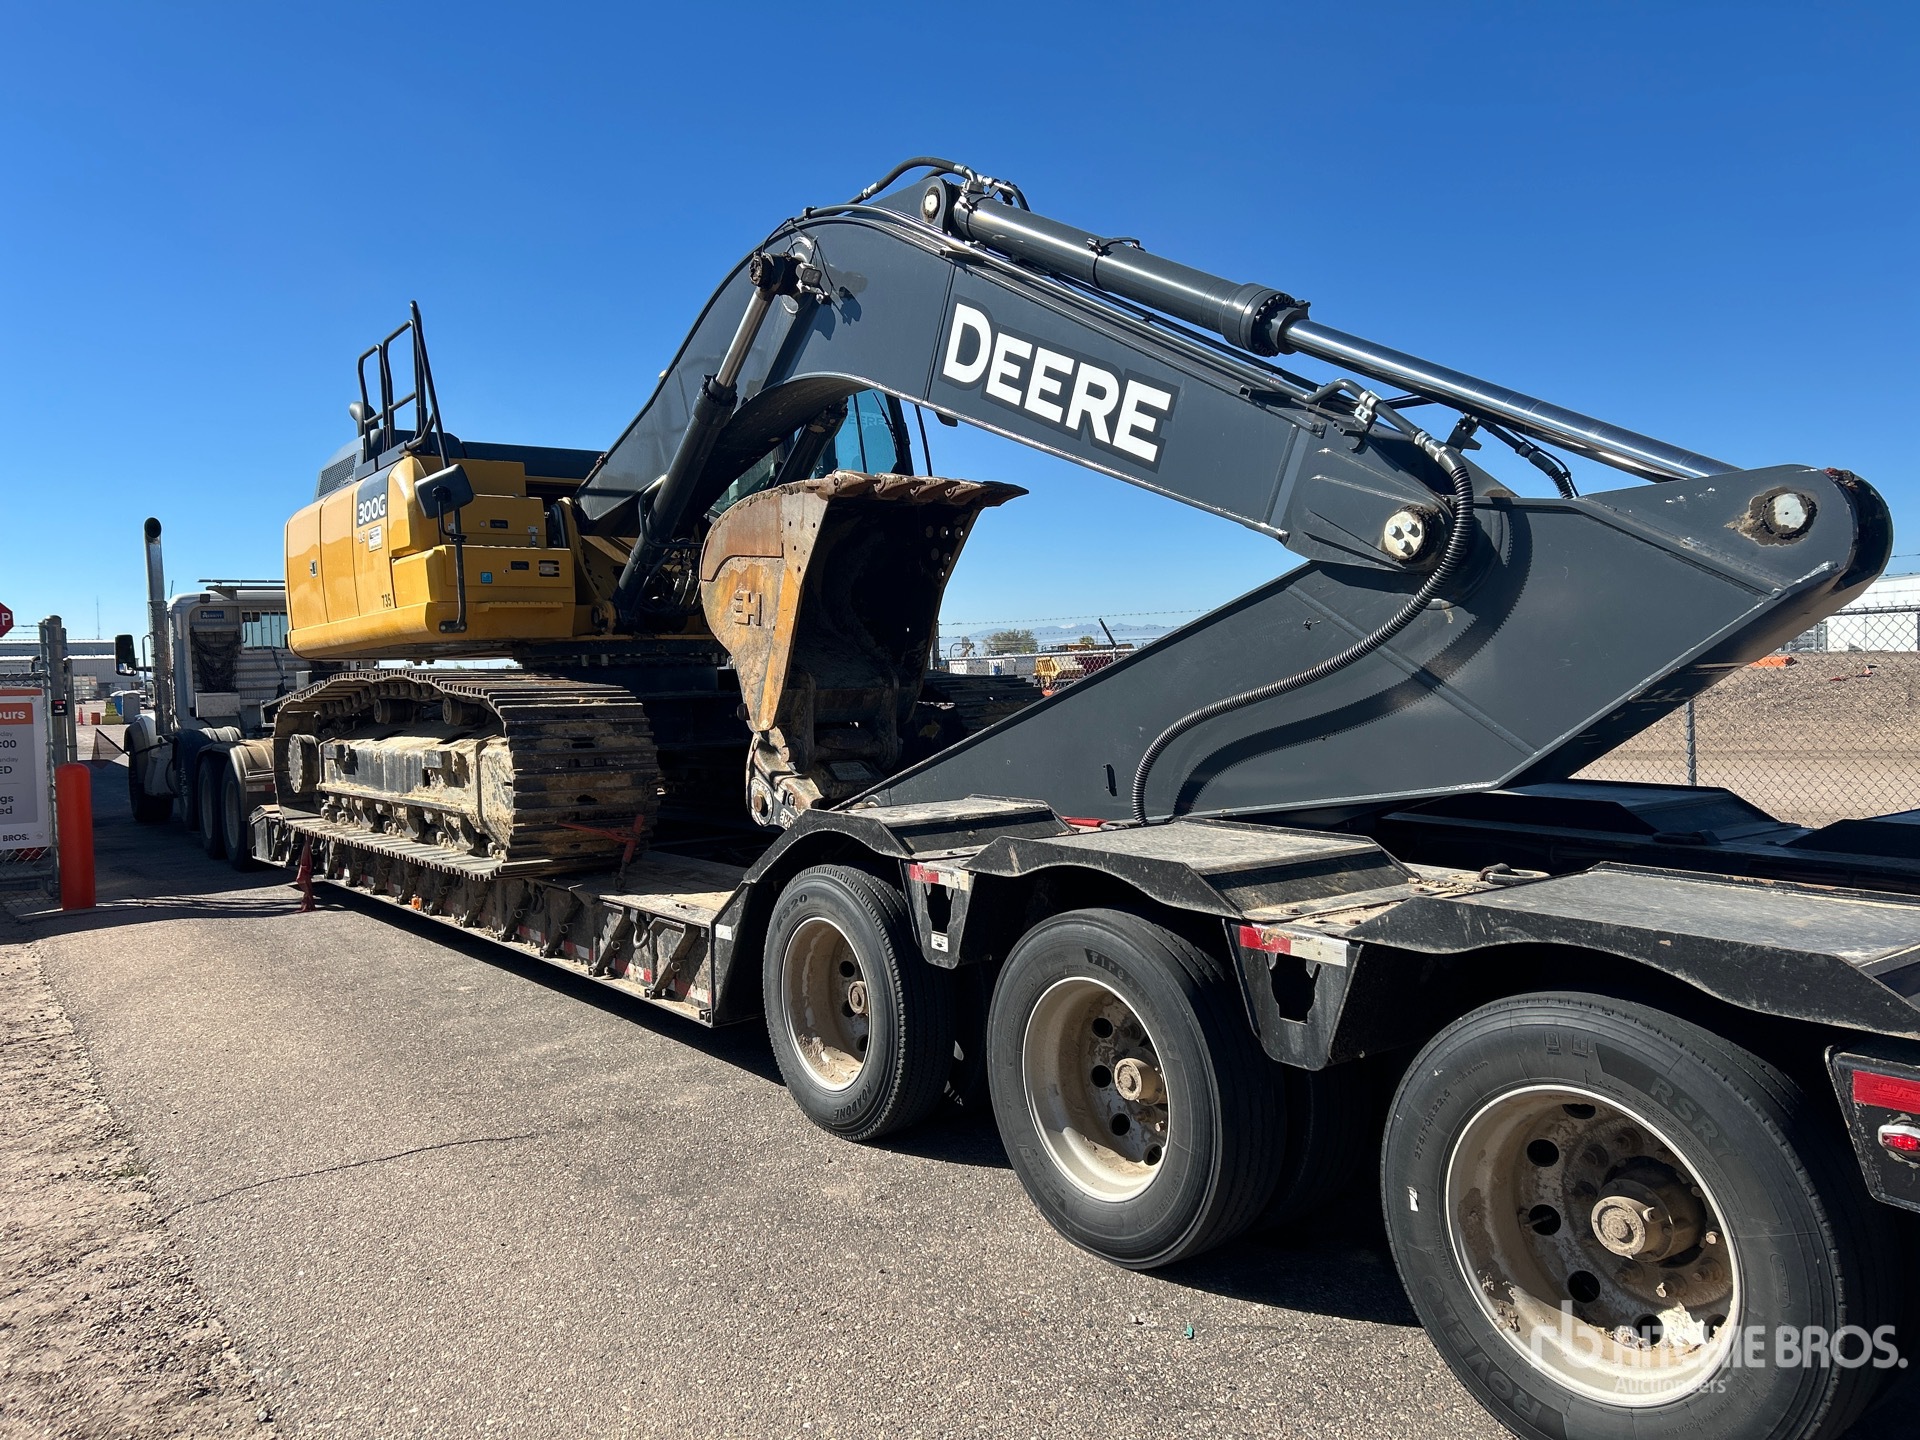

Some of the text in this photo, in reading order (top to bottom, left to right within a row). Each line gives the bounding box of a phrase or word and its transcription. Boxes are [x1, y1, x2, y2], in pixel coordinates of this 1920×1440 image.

[942, 302, 1172, 463] DEERE
[358, 493, 386, 525] 300G
[833, 1080, 873, 1121] ROADONE
